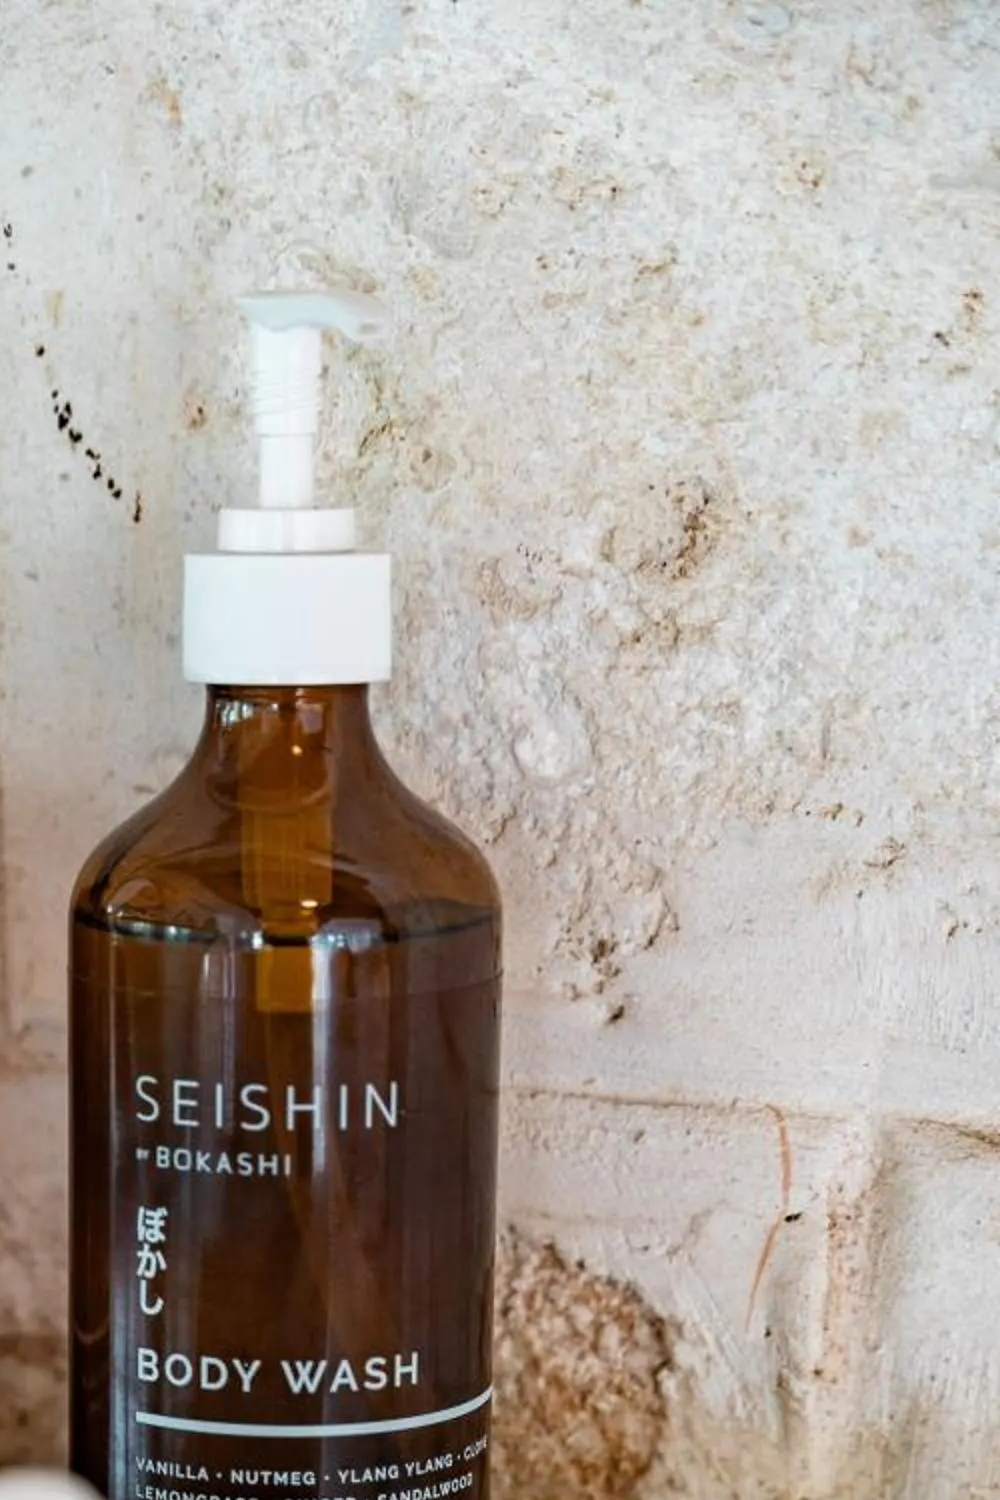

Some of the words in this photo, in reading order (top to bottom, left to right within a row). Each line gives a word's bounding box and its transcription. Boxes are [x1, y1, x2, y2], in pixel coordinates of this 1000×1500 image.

[135, 1076, 398, 1131] SEISHIN
[156, 1145, 291, 1176] BOKASHI
[137, 1207, 167, 1316] ぼかし
[137, 1347, 262, 1393] BODY
[282, 1351, 420, 1394] WASH
[136, 1457, 209, 1481] VANILLA
[231, 1470, 316, 1486] NUTMEG
[338, 1464, 399, 1484] YLANG
[404, 1454, 454, 1476] YLANG
